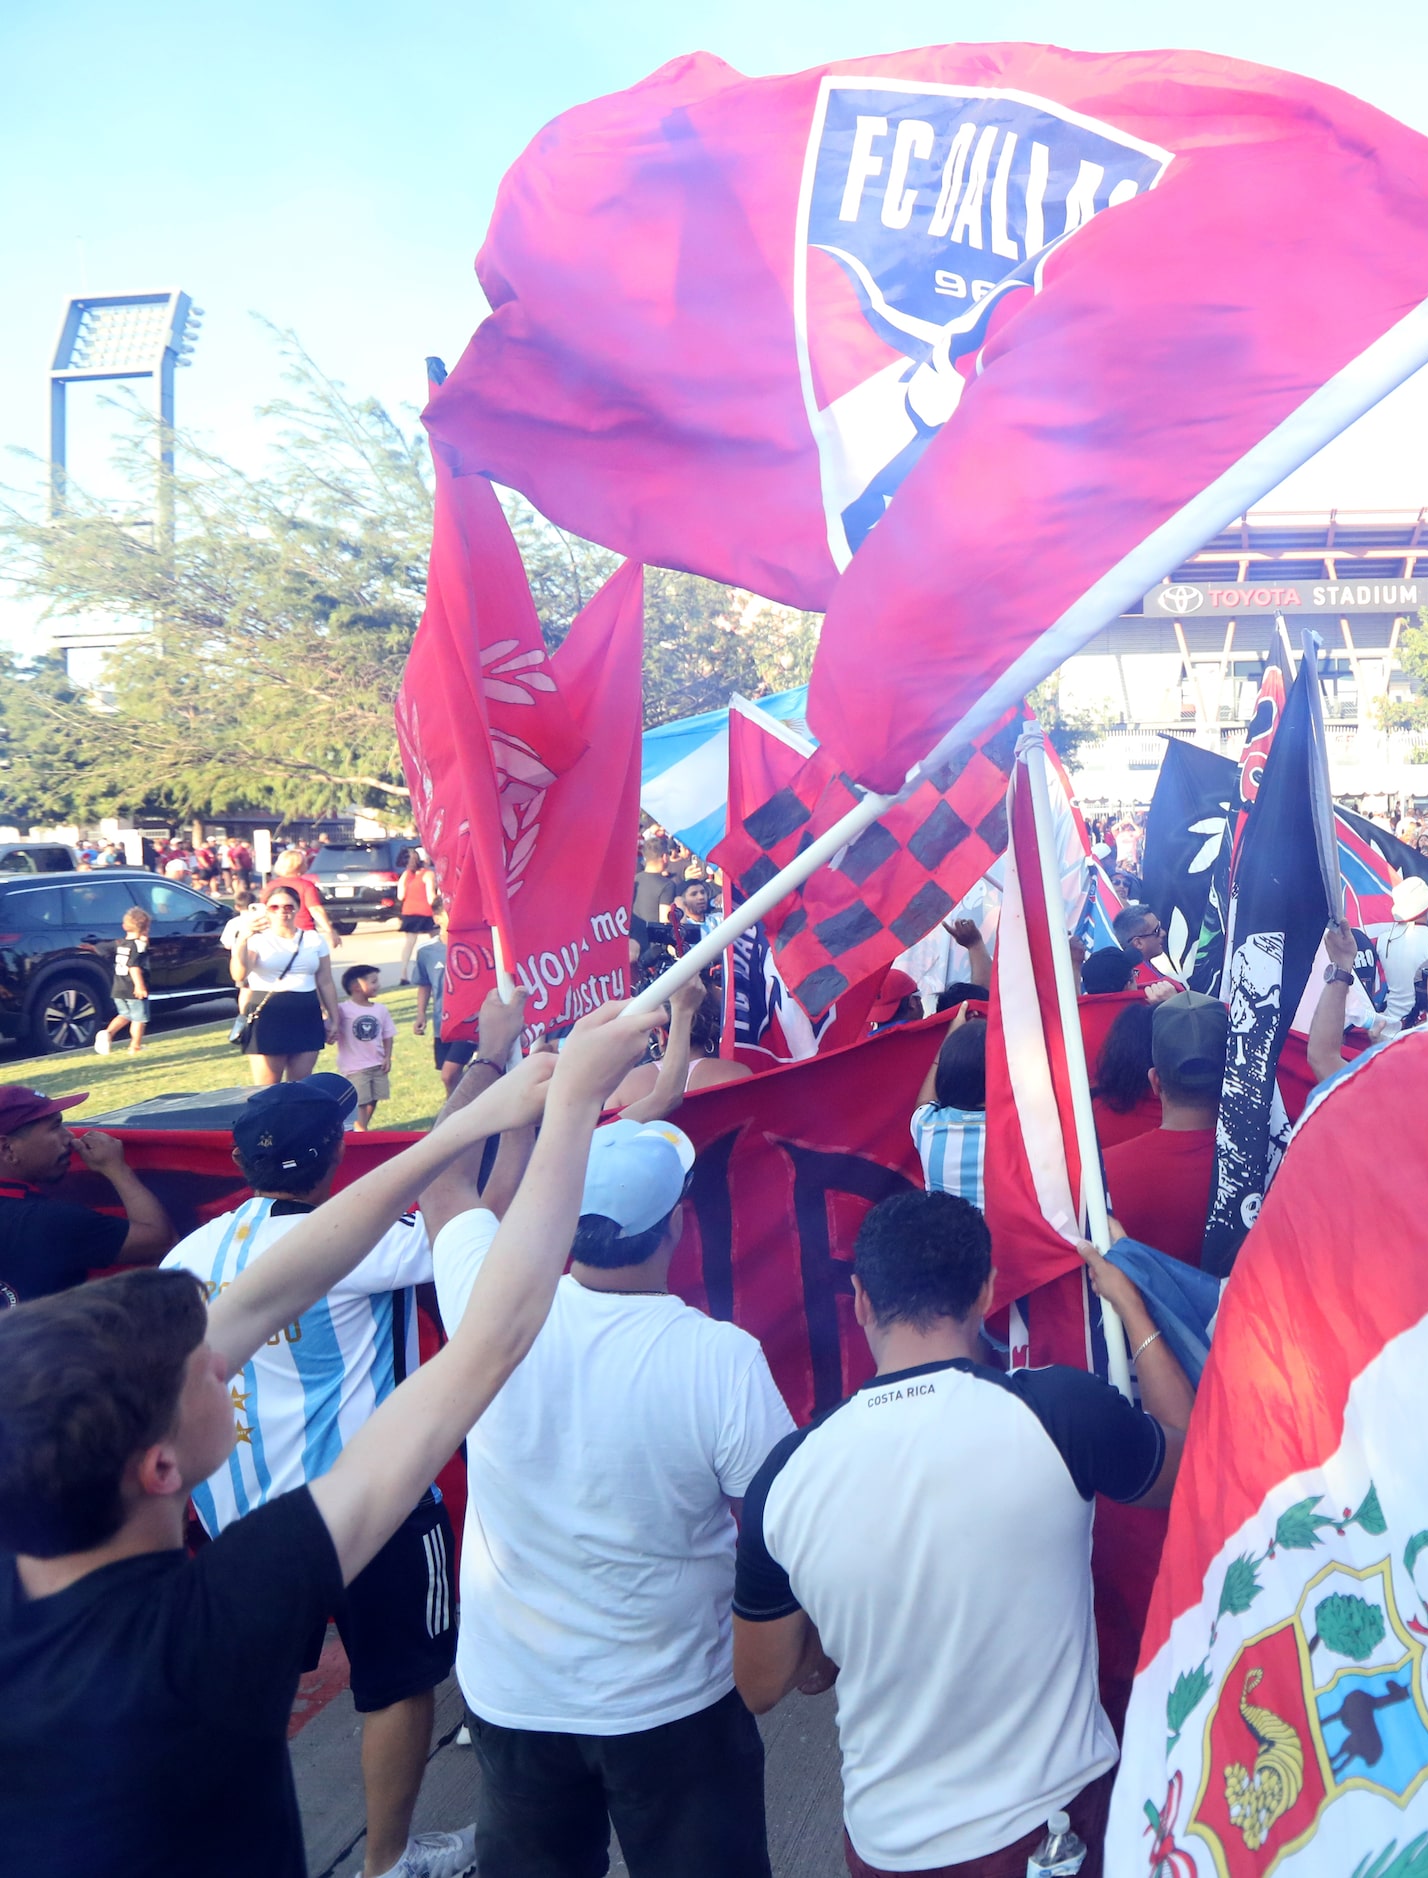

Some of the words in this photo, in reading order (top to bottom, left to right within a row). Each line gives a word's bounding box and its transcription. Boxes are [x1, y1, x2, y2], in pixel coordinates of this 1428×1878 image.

[838, 114, 936, 231] FC
[1209, 587, 1302, 608] TOYOTA
[1312, 584, 1417, 606] STADIUM
[590, 905, 630, 943] me
[1353, 948, 1375, 969] RO
[867, 1390, 903, 1408] COSTA
[906, 1384, 935, 1398] RICA
